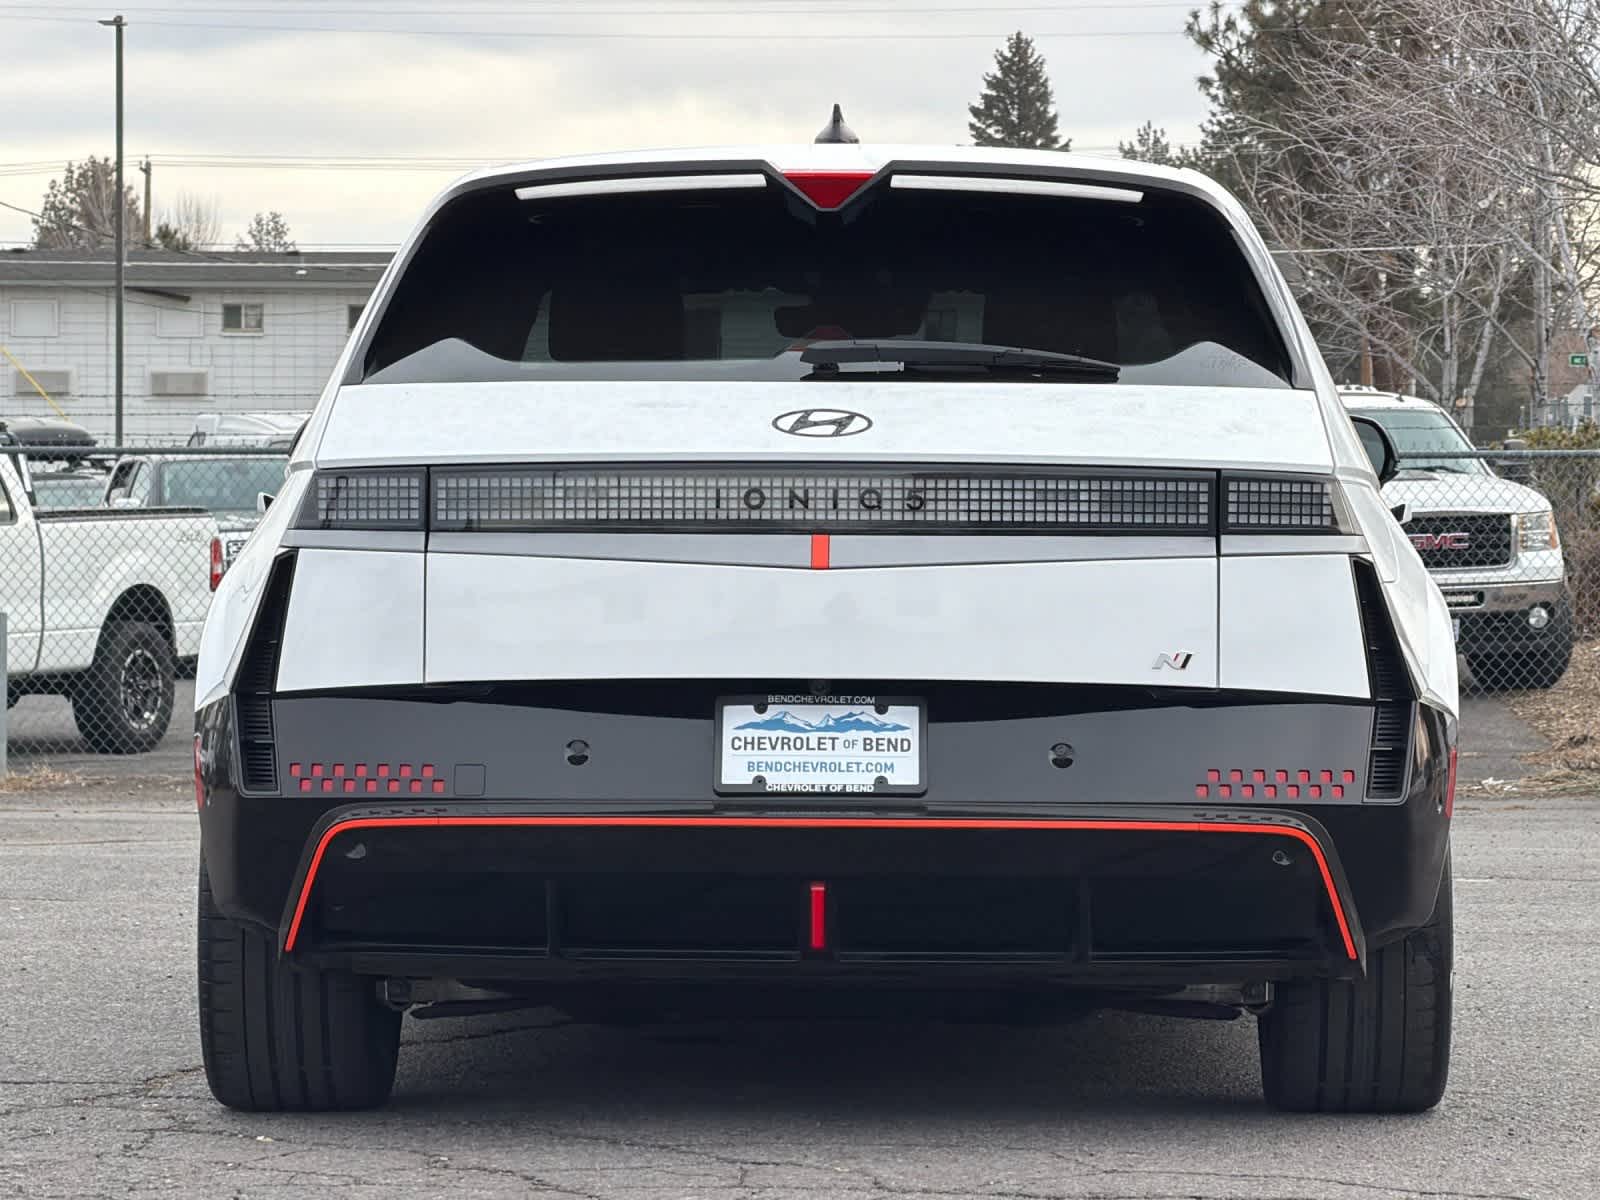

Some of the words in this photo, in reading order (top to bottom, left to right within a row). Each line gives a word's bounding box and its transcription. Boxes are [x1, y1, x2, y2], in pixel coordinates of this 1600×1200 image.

[715, 488, 882, 510] IONIQ
[906, 489, 925, 510] 5
[767, 695, 876, 704] BENDCHEVROLET.COM
[731, 736, 839, 751] CHEVROLET
[843, 739, 859, 749] OF
[863, 737, 911, 752] BEND
[747, 761, 894, 773] BENDCHEVROLET.COM
[766, 784, 827, 792] CHEVROLET
[829, 784, 844, 792] OF
[846, 784, 875, 792] BEND
